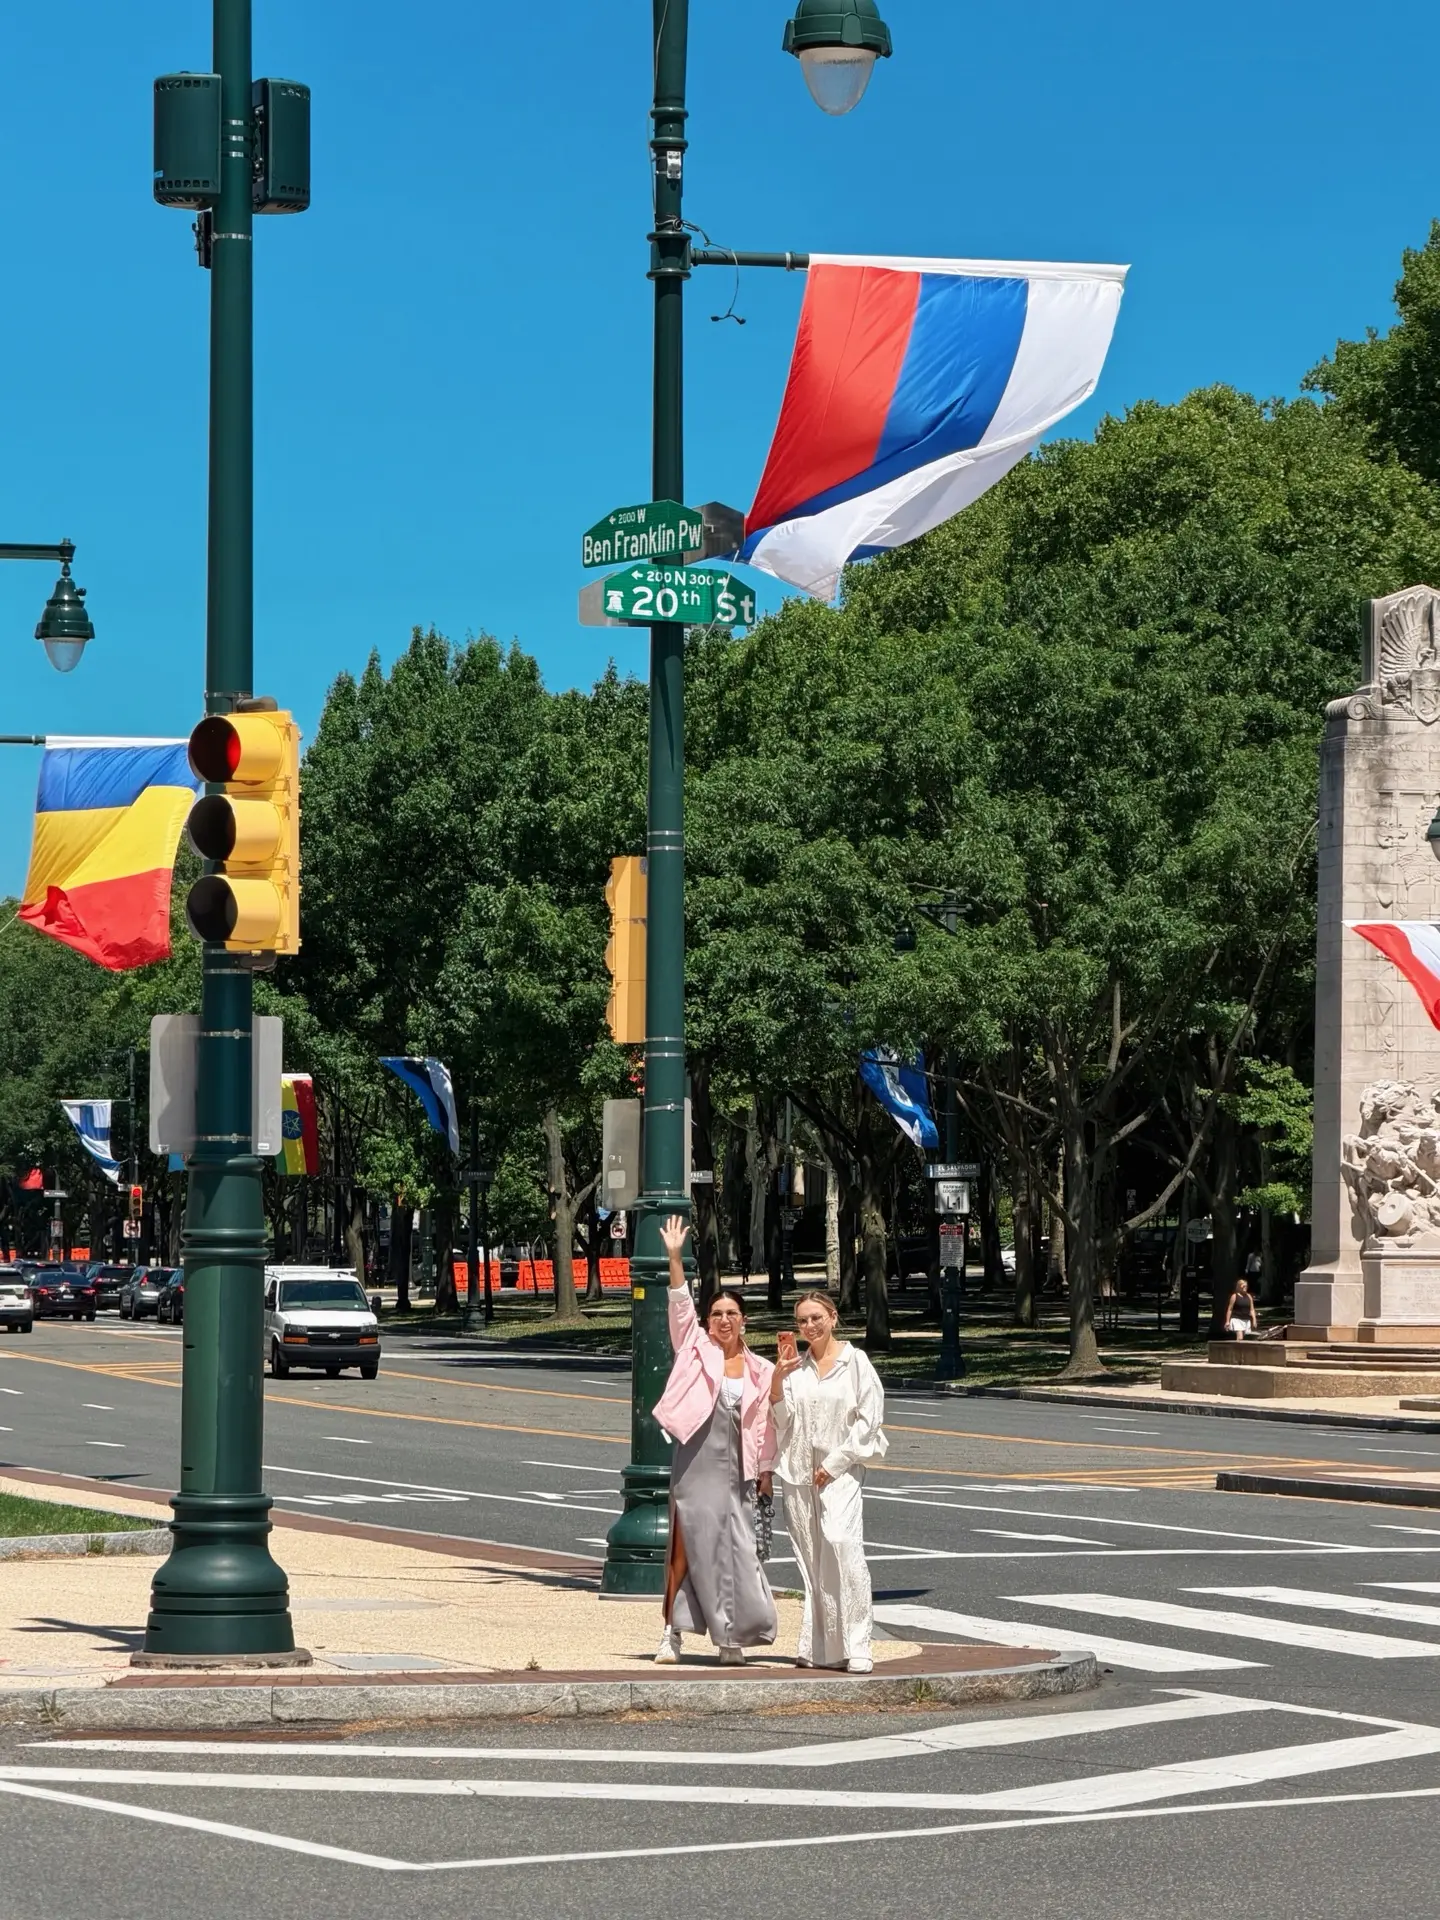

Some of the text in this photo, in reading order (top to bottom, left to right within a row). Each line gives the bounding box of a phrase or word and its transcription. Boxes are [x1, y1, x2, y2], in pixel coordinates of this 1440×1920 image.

[618, 507, 647, 524] 2000 W
[583, 519, 703, 565] Ben Franklin Pw
[647, 571, 715, 587] 200 N 300
[631, 586, 755, 627] 20th St
